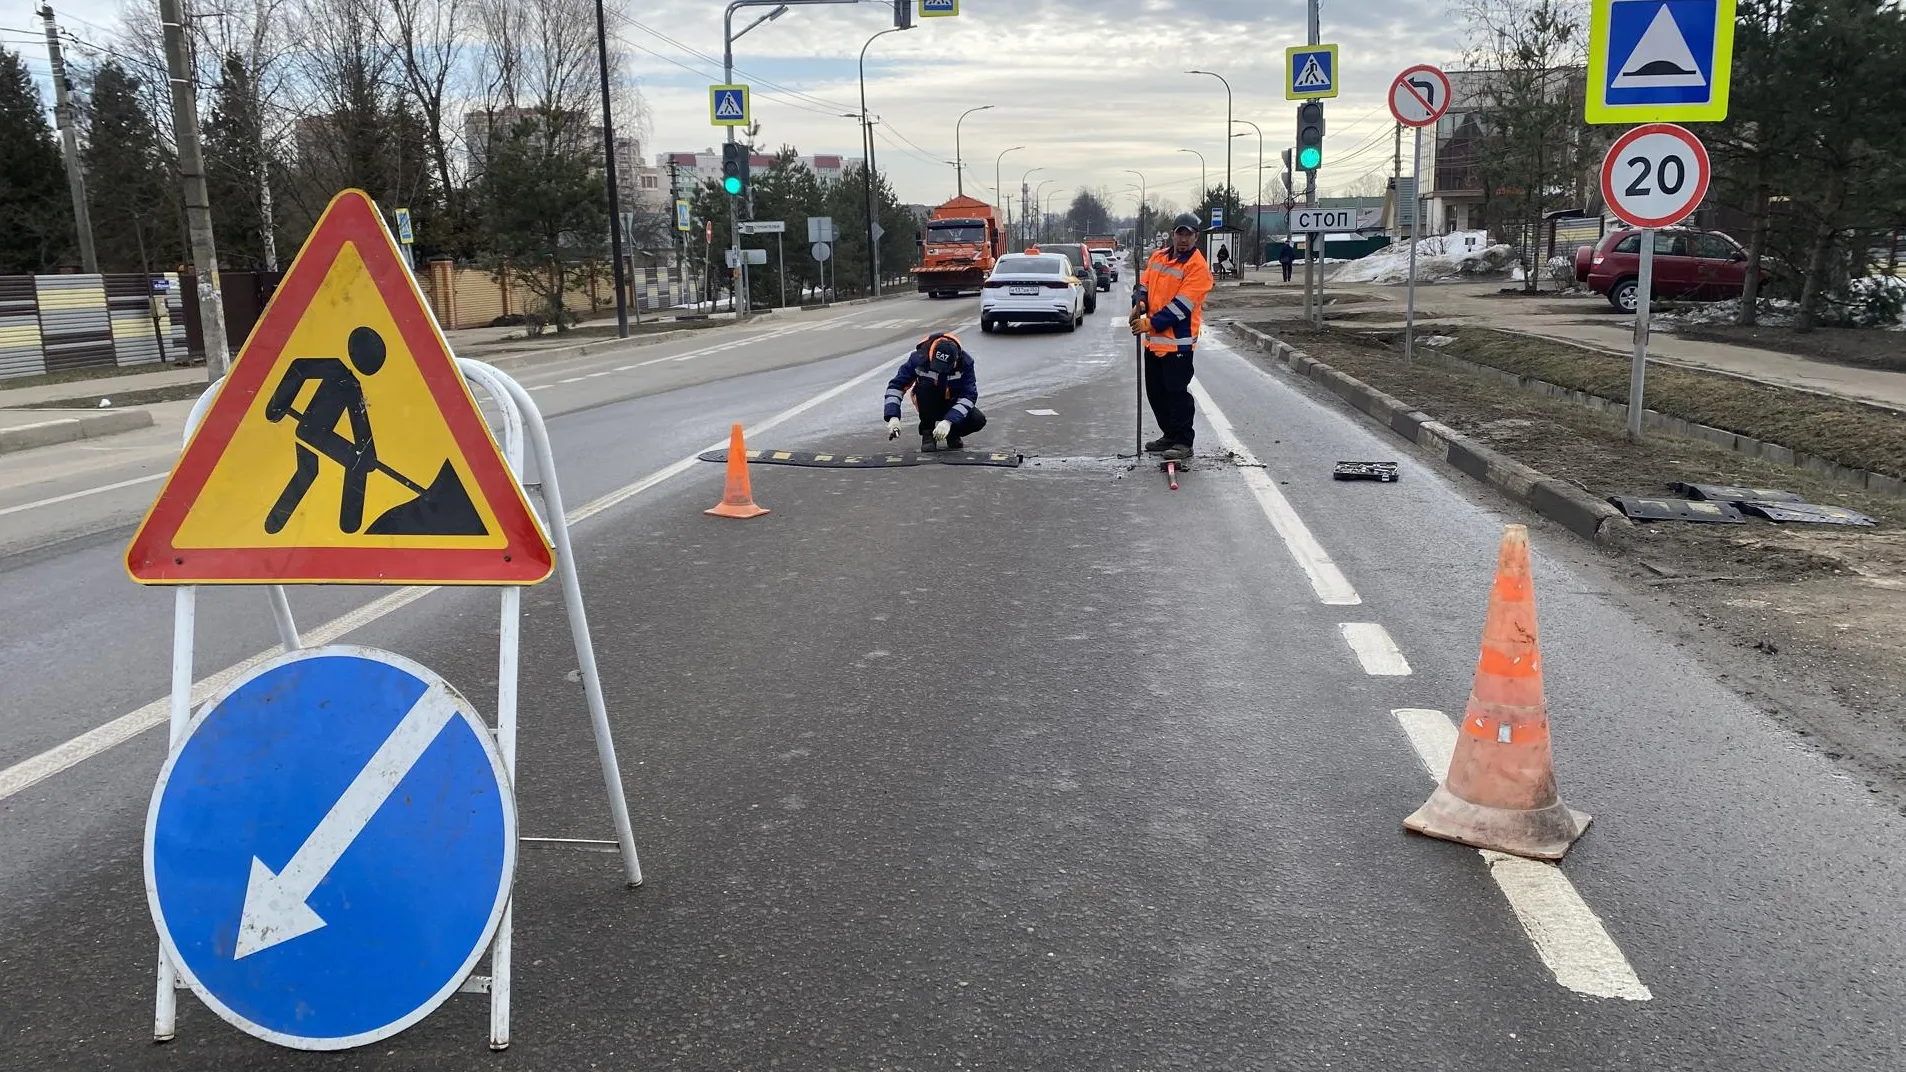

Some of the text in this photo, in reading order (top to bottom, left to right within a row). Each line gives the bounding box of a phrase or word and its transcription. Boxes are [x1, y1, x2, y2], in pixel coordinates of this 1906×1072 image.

[1625, 155, 1685, 196] 20
[1299, 212, 1348, 227] СТОП
[936, 351, 950, 360] EA7
